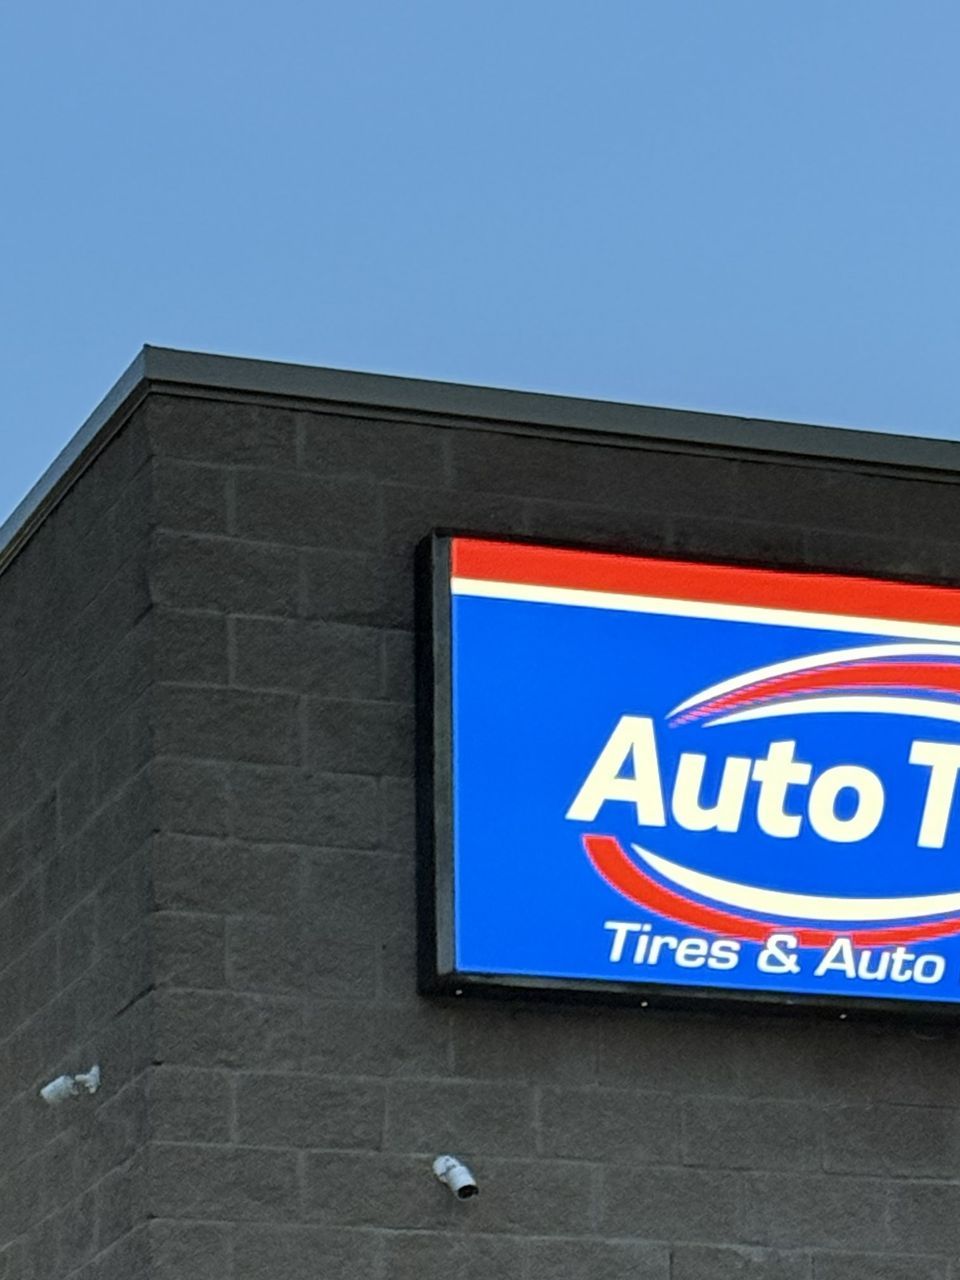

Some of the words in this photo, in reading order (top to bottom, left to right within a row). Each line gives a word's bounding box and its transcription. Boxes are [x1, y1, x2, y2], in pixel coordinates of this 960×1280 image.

[565, 714, 885, 844] Auto
[604, 920, 741, 971] Tires
[756, 932, 800, 974] &
[815, 936, 946, 985] Auto
